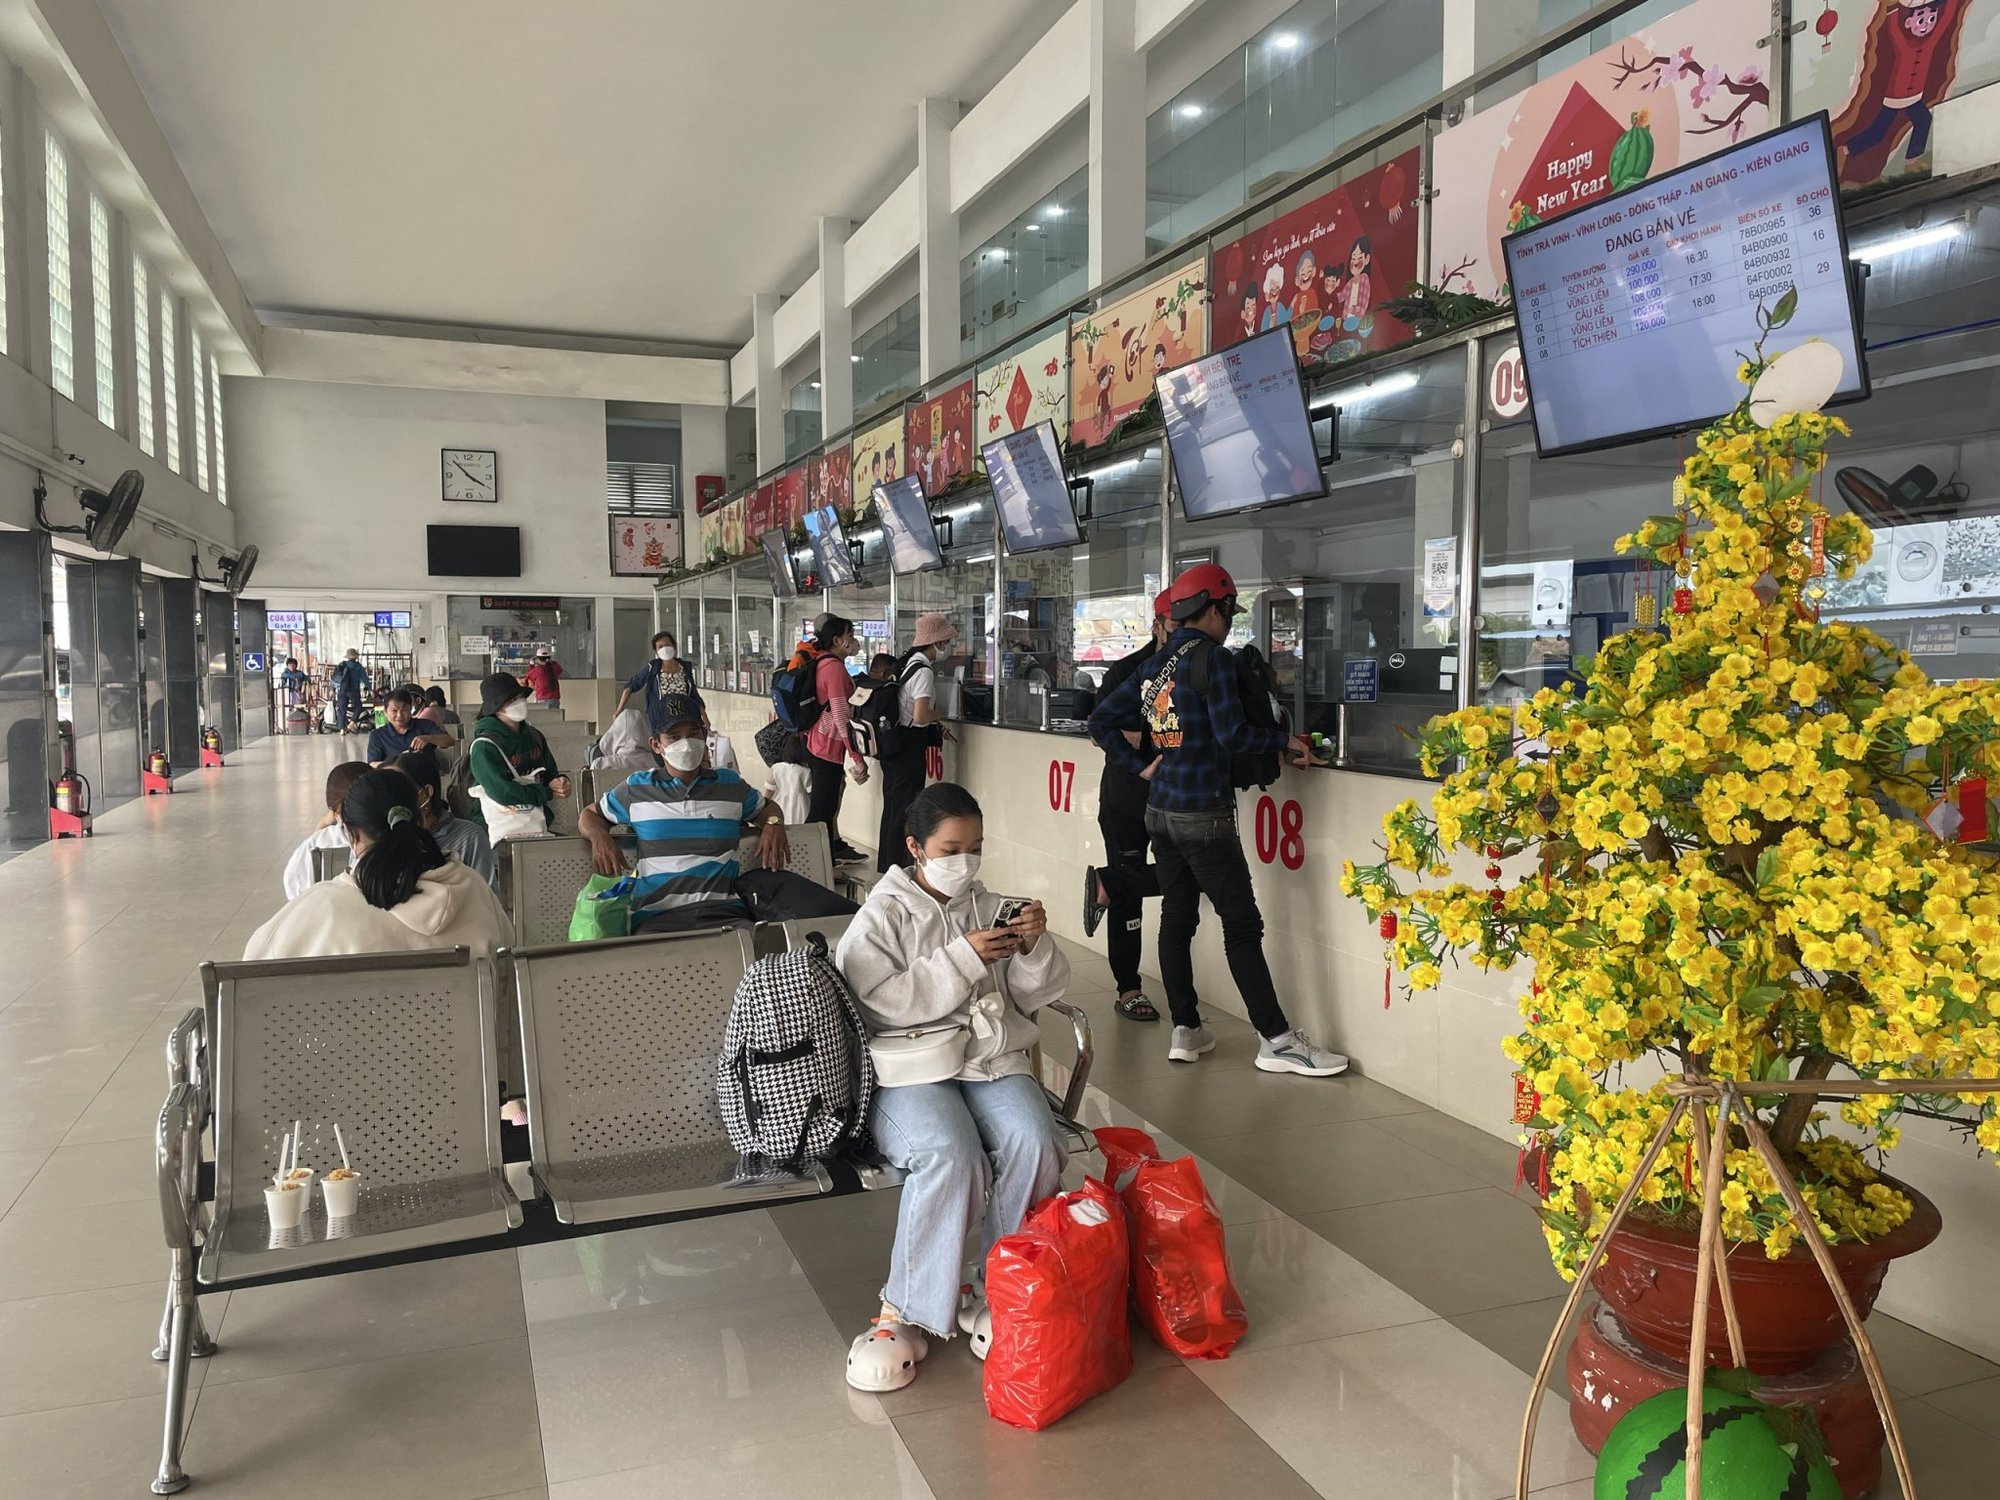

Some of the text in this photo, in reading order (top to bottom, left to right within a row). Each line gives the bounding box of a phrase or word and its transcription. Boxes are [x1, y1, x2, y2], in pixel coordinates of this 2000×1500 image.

[1546, 150, 1593, 181] Happy
[1536, 174, 1608, 214] New Year
[1597, 212, 1622, 230] LONG
[1689, 182, 1703, 196] AN
[1705, 168, 1738, 189] GIANG
[1746, 155, 1772, 173] KIÊN
[1774, 141, 1810, 163] GIANG
[1771, 203, 1783, 213] XE
[1808, 205, 1821, 218] 36
[1605, 206, 1697, 253] ĐANG BÁN VÉ
[1739, 216, 1786, 240] 78B00965
[1813, 229, 1825, 242] 16
[1741, 232, 1788, 255] 84B00900
[1744, 248, 1791, 271] 84B00932
[1817, 261, 1830, 274] 29
[1689, 271, 1712, 287] 17:30
[1746, 264, 1792, 285] 64F00002
[1226, 353, 1242, 368] TRE
[1496, 358, 1528, 406] 09
[927, 746, 943, 782] 06
[1049, 760, 1075, 813] 07
[1255, 795, 1305, 871] 08
